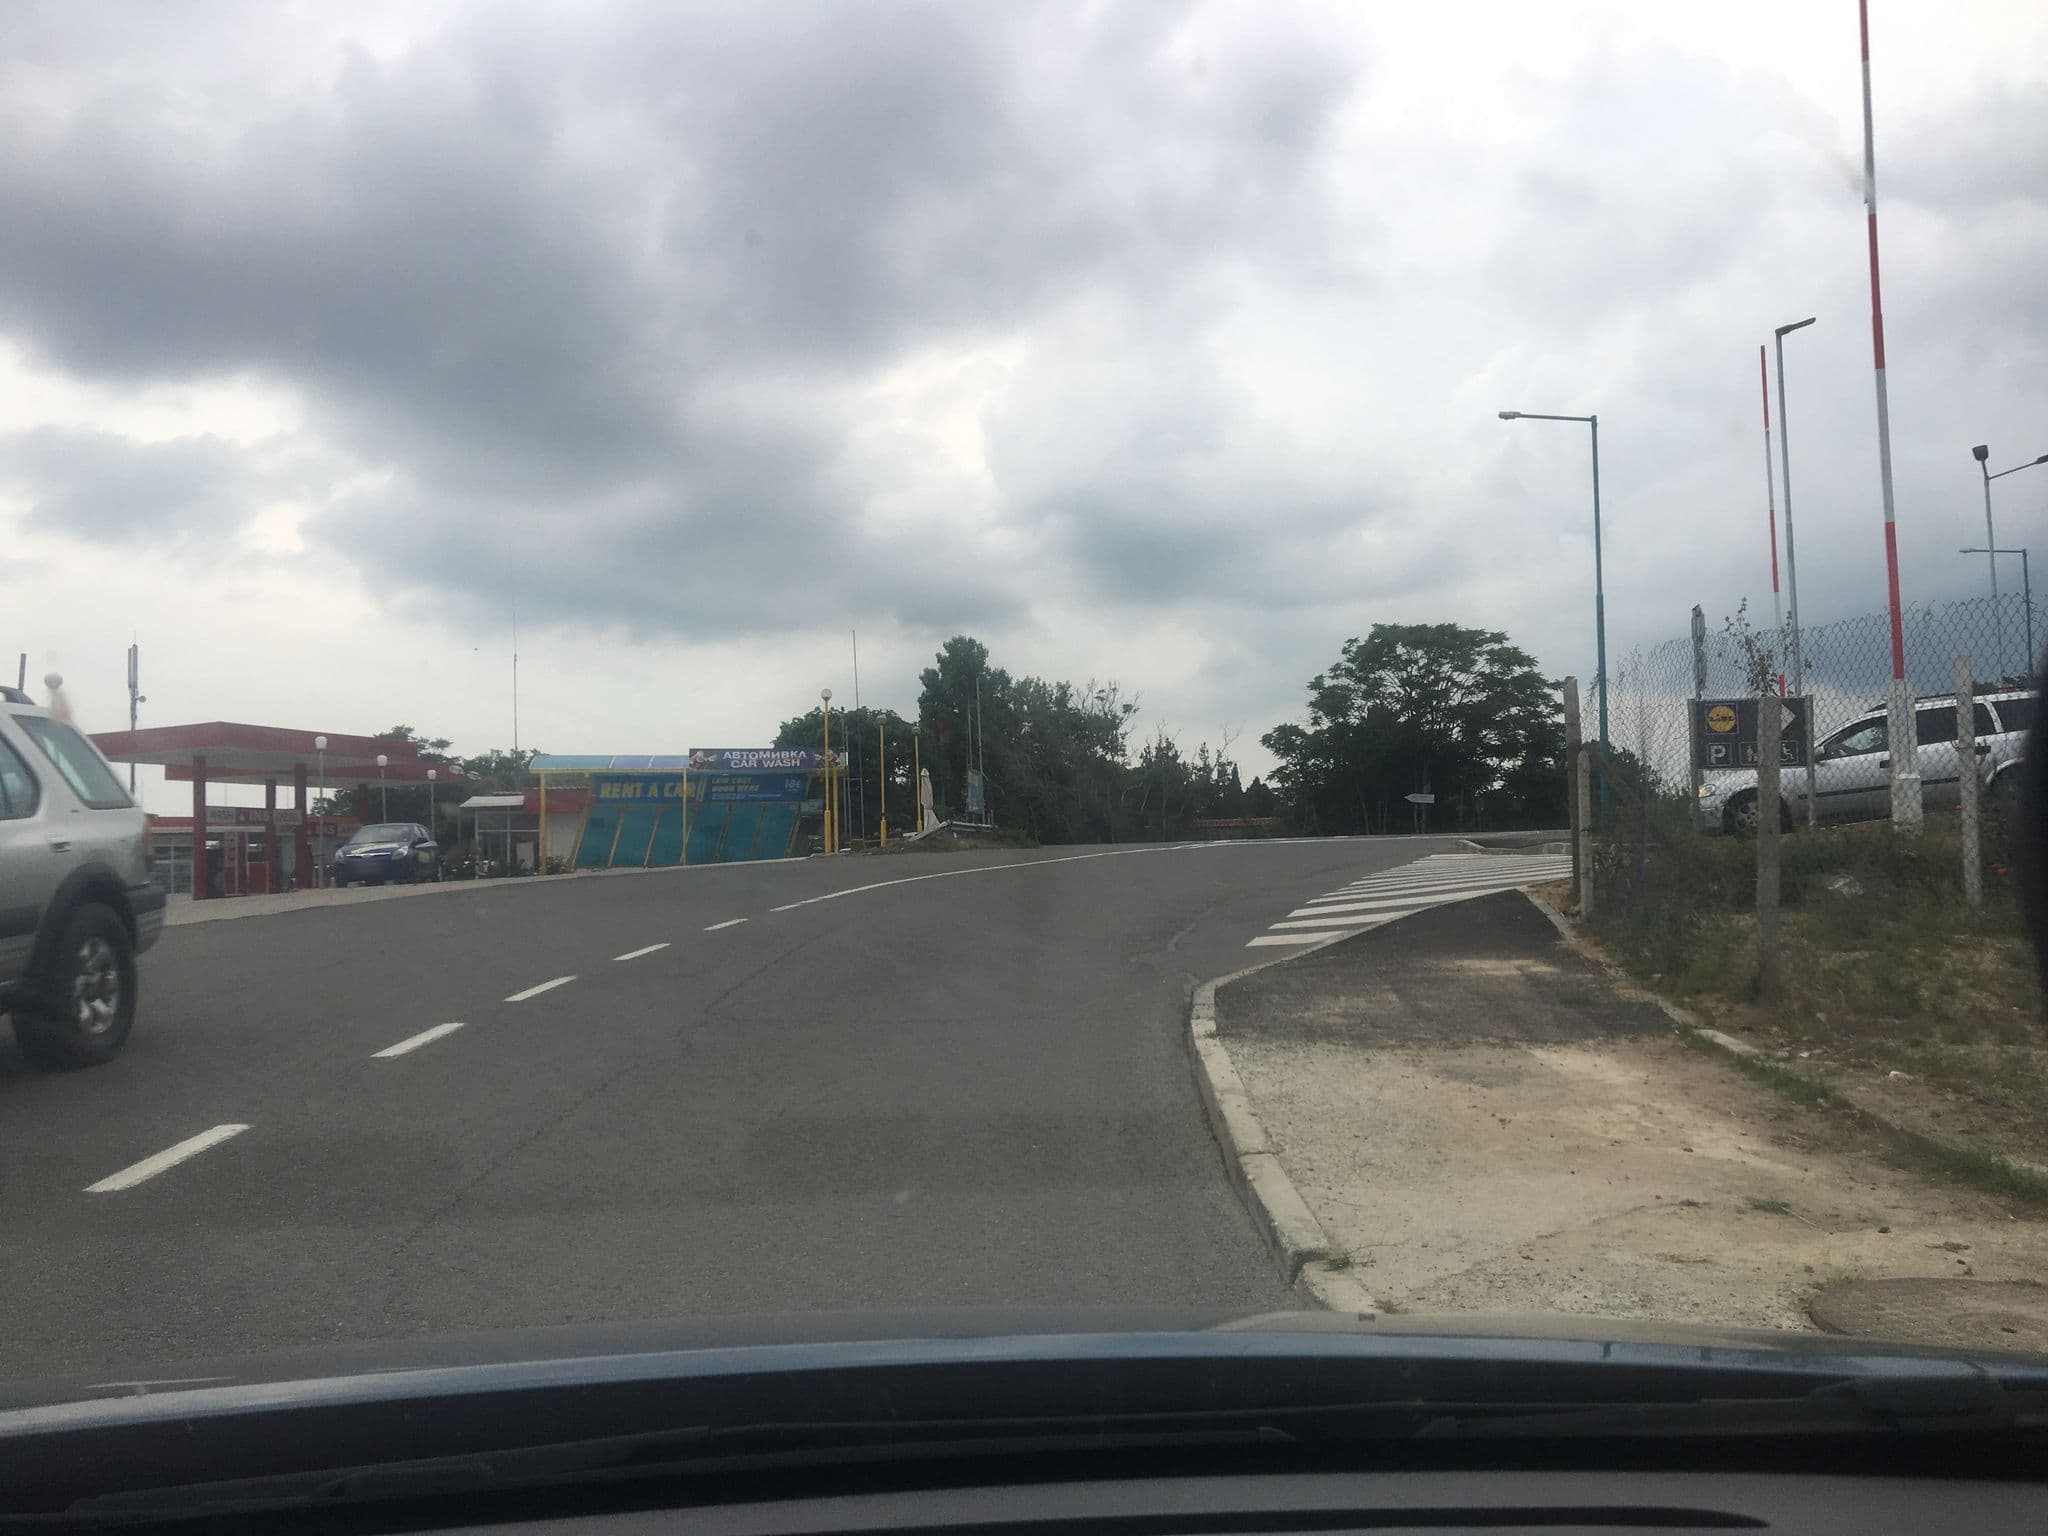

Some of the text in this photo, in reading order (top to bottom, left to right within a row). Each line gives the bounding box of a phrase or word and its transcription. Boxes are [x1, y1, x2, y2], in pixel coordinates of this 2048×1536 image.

[723, 751, 807, 760] АВТОМИВКА
[1710, 745, 1726, 764] P
[731, 759, 801, 768] CAR WASH
[600, 783, 642, 798] RENT
[648, 783, 658, 798] A
[664, 783, 696, 798] CAR
